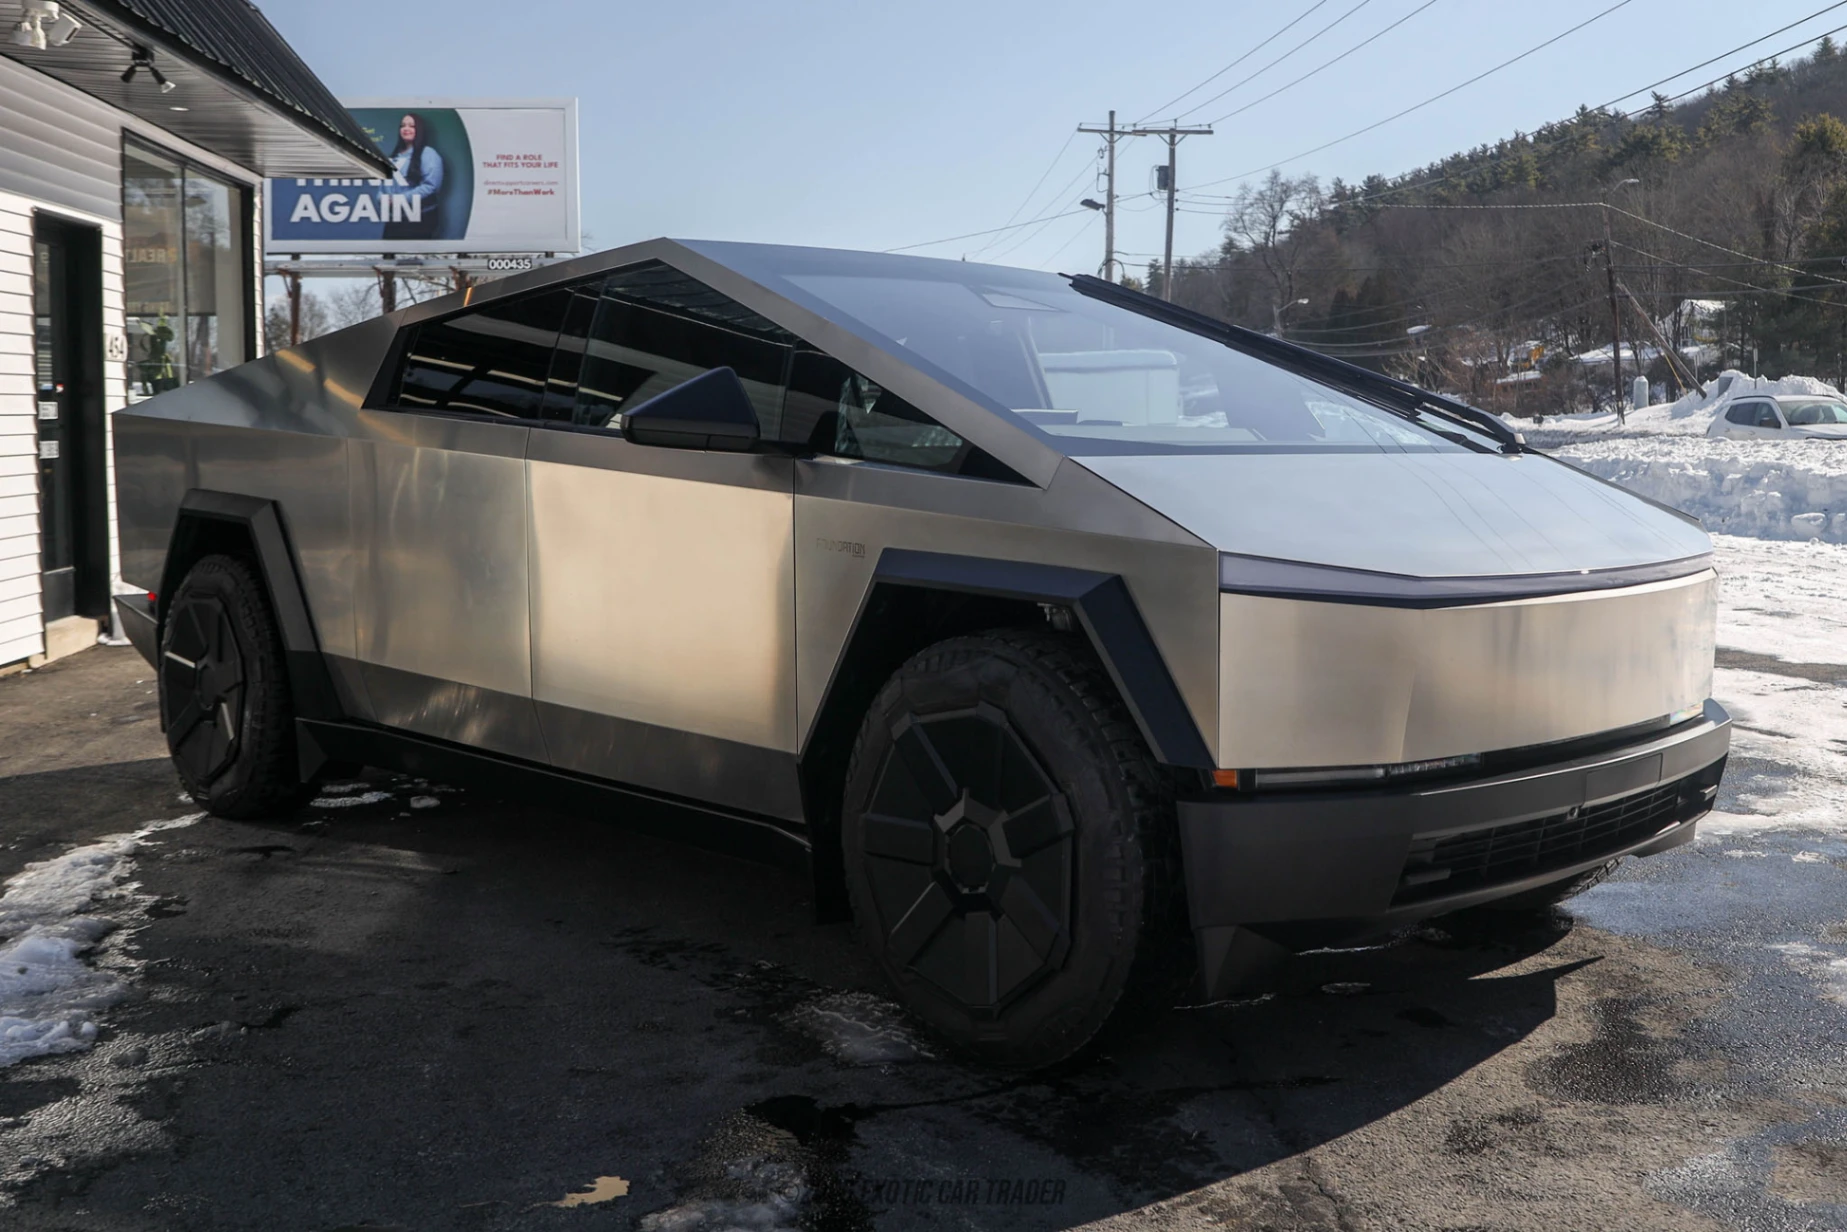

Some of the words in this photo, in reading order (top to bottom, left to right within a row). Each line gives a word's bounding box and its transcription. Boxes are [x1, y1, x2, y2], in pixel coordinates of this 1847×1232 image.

[487, 188, 555, 196] #MoreThanWork
[290, 193, 422, 223] AGAIN
[489, 259, 531, 270] 000435
